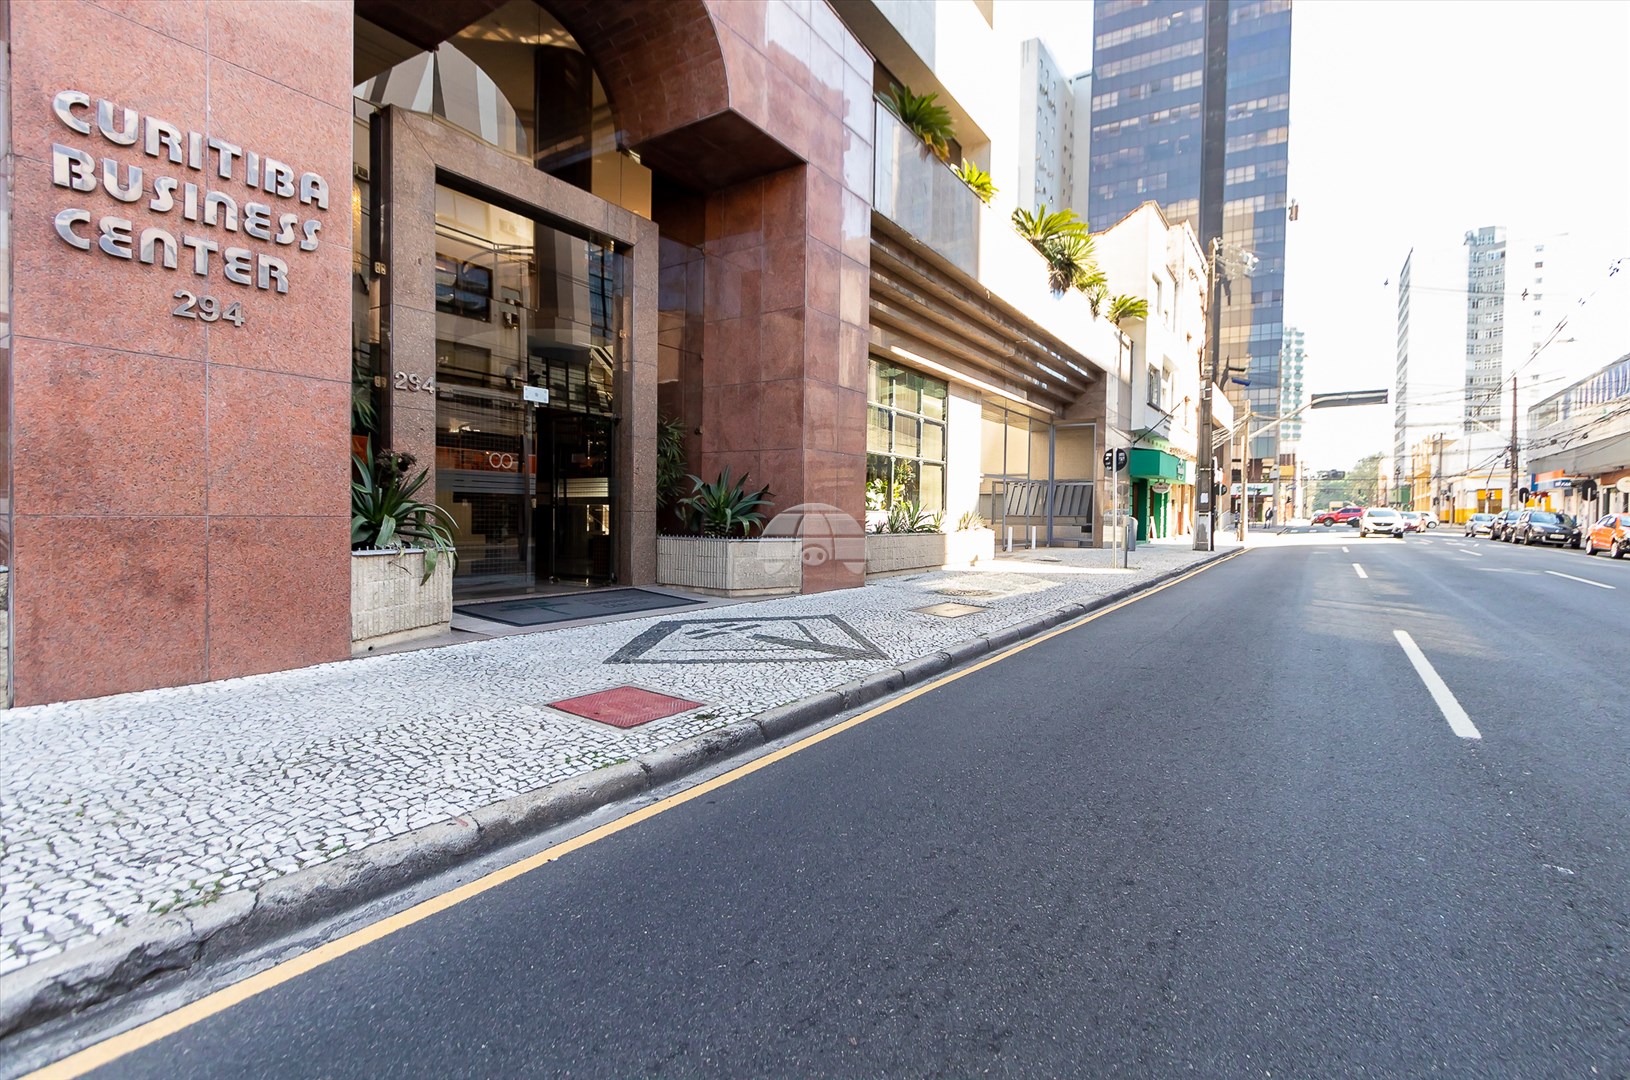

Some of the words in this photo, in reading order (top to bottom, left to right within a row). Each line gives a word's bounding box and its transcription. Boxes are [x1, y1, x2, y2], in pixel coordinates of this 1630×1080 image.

[52, 90, 329, 209] CURITIBA
[52, 143, 322, 251] BUSINESS
[54, 208, 289, 293] CENTER
[173, 289, 245, 327] 294
[394, 371, 435, 394] 294
